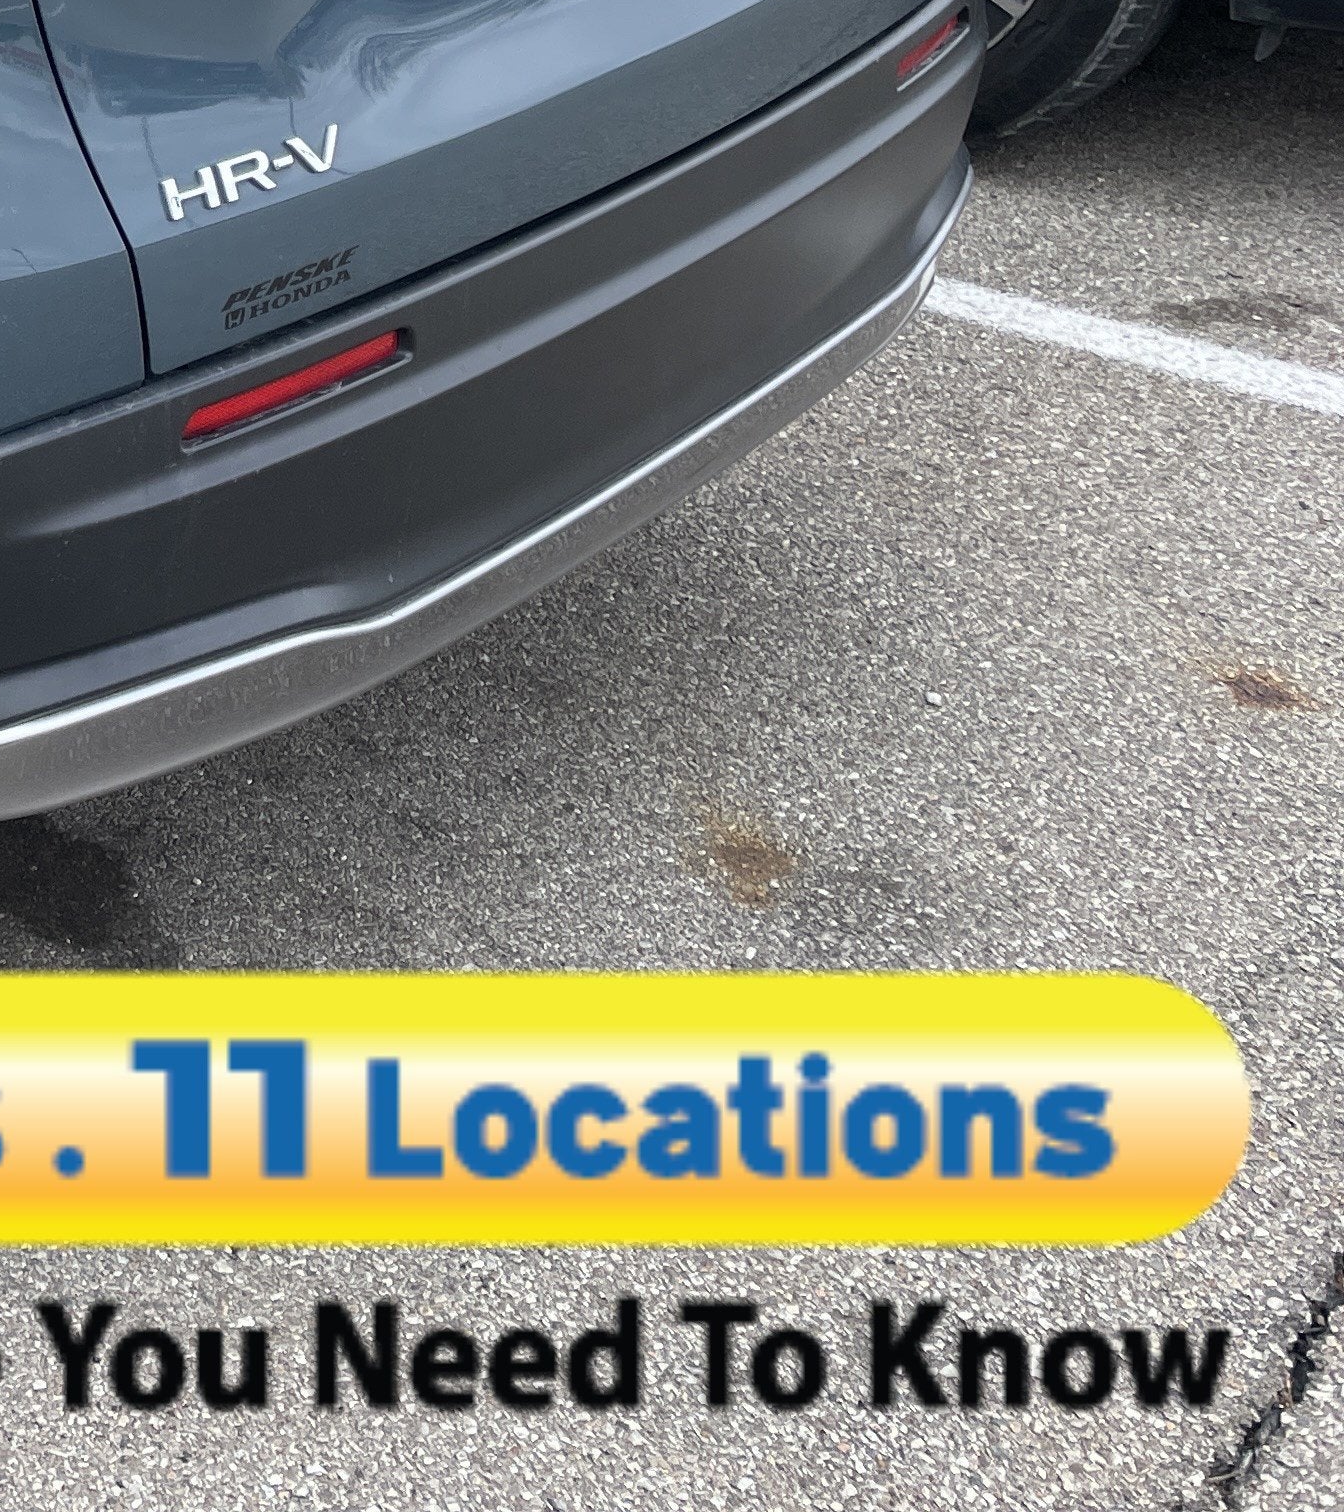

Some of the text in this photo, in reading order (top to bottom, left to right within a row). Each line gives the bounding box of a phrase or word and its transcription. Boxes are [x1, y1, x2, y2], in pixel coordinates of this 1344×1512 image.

[160, 122, 339, 222] HR-V
[221, 244, 360, 313] PENSKE
[248, 269, 352, 320] HONDA
